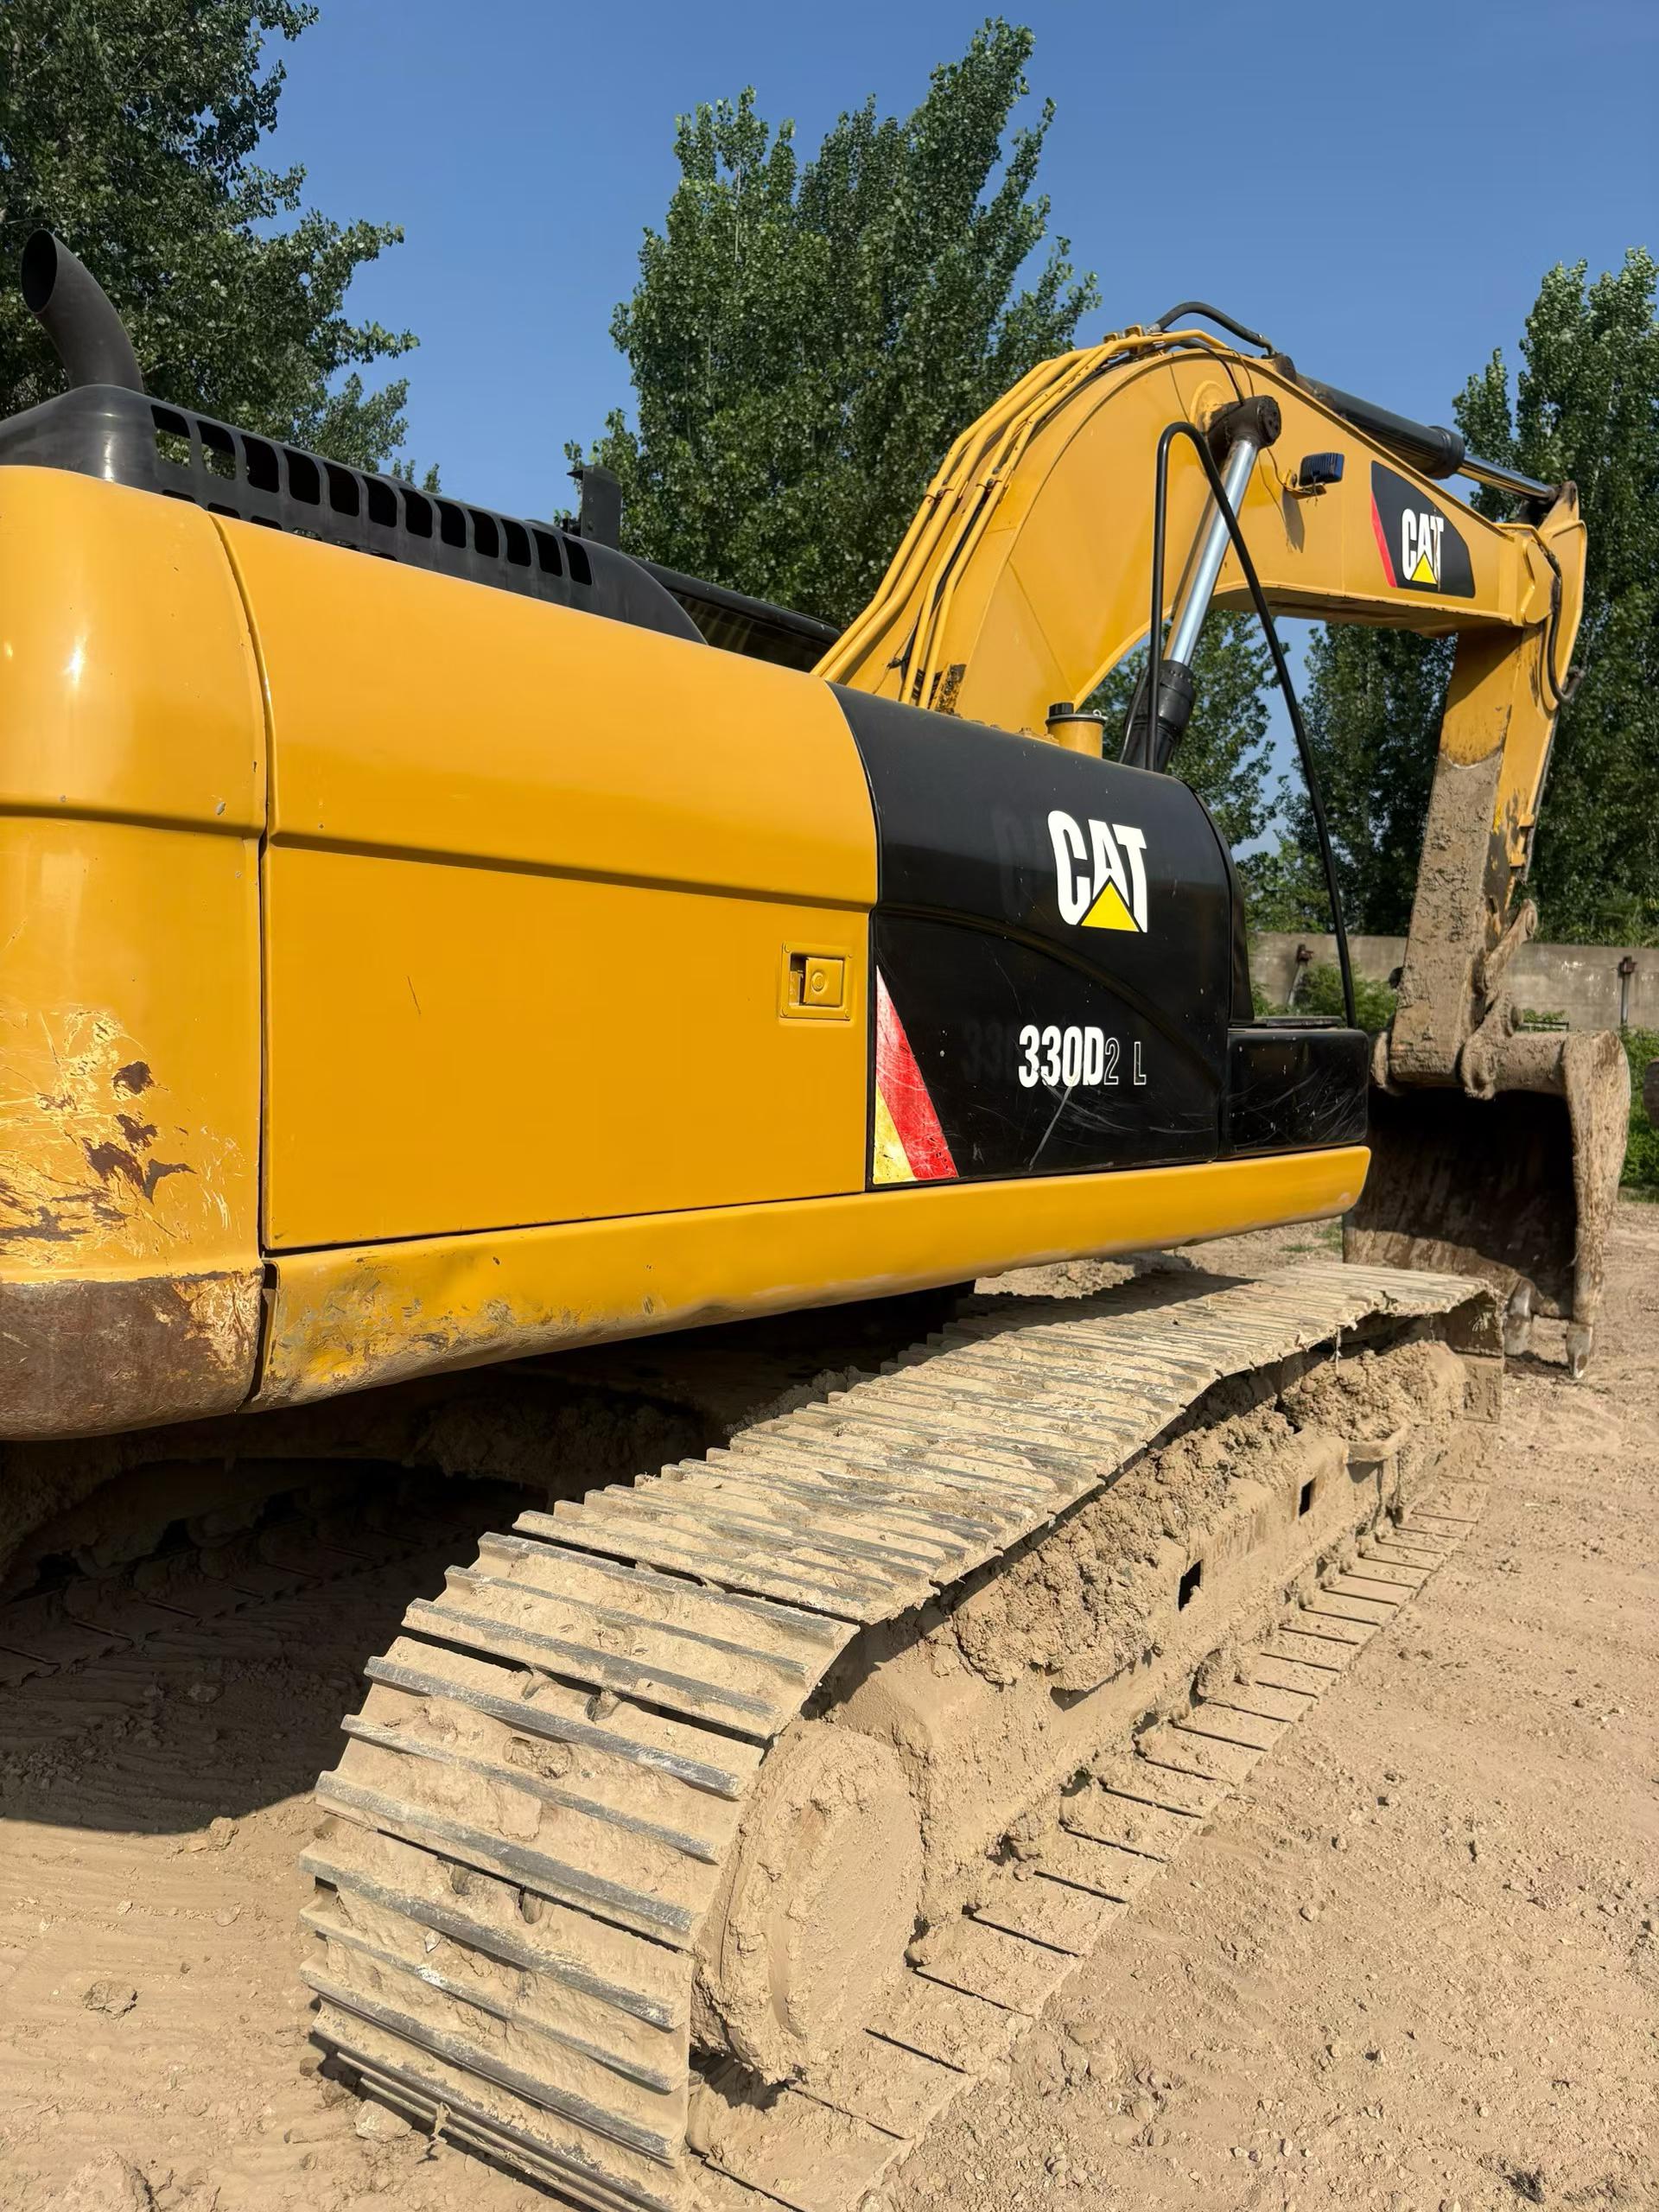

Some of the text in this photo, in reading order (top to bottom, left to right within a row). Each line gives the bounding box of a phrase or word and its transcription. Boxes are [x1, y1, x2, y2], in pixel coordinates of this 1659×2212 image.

[1402, 508, 1445, 583] CAT
[1047, 810, 1148, 933] CAT
[1018, 1024, 1120, 1088] 330D2
[1133, 1040, 1147, 1086] L
